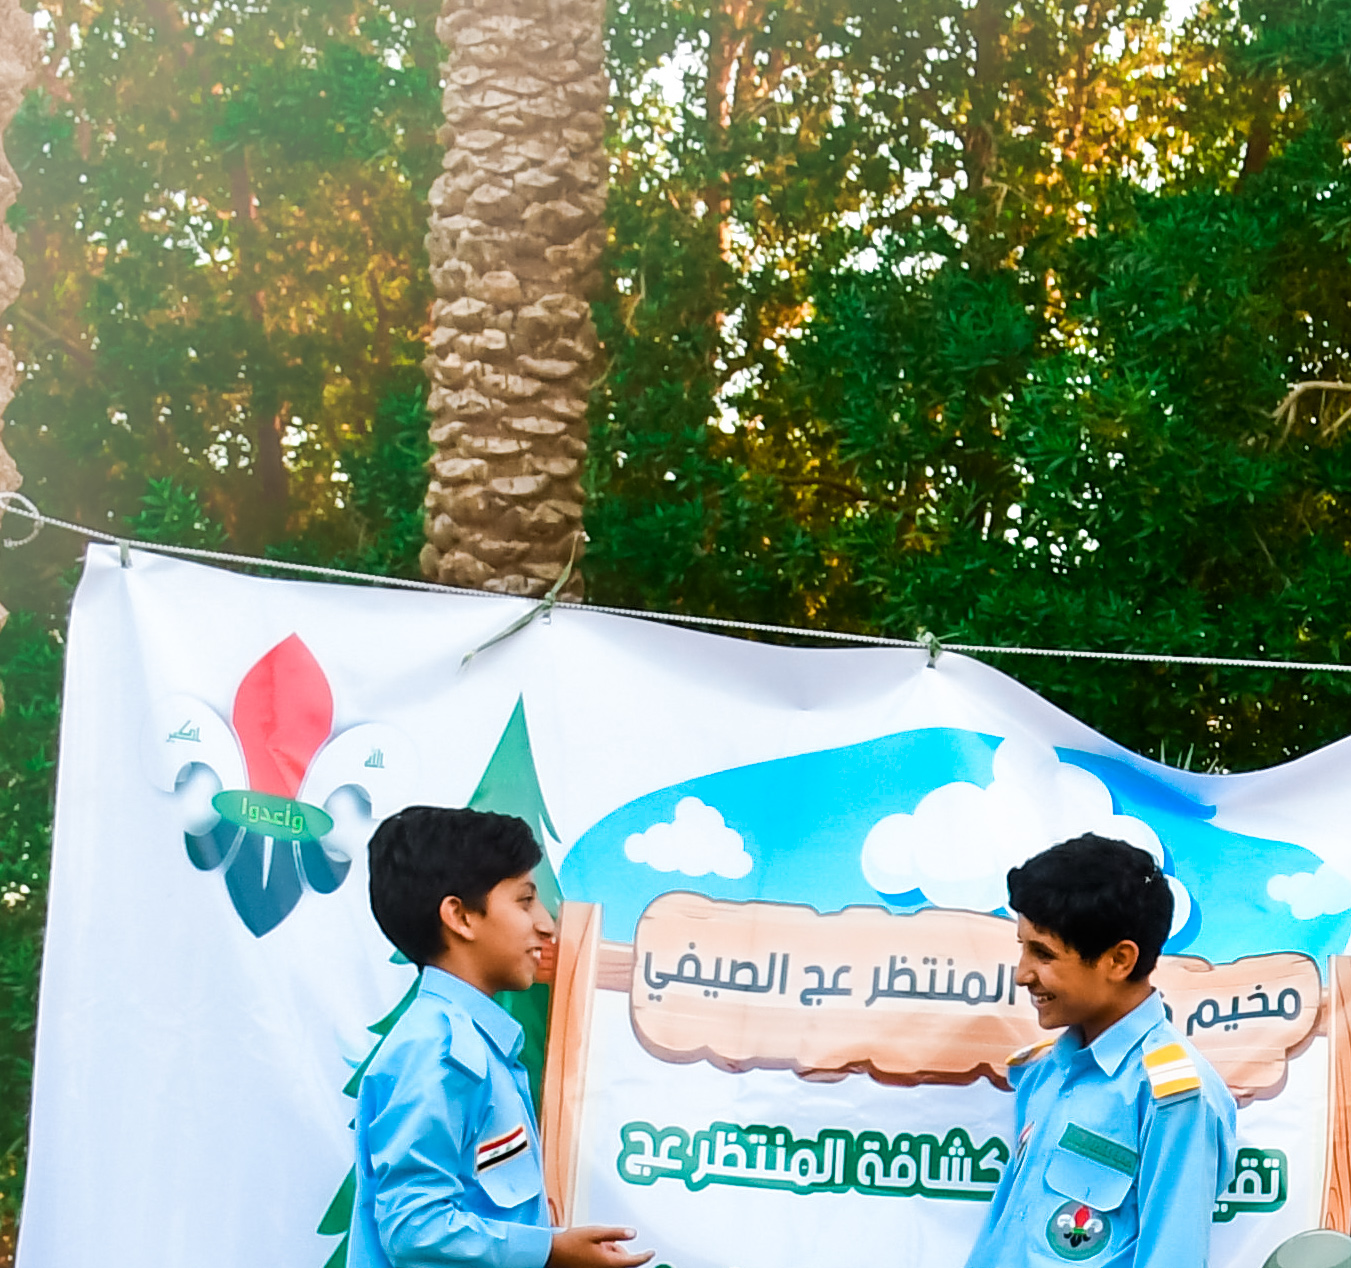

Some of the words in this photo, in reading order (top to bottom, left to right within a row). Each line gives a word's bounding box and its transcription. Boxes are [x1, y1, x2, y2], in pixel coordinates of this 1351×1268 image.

[643, 942, 790, 1002] الصيفي
[799, 964, 852, 1006] عج
[864, 954, 1017, 1007] المنتظر
[1186, 984, 1302, 1037] مخيم
[625, 1130, 682, 1177] عج
[690, 1130, 846, 1186] المنتظر
[856, 1136, 1005, 1191] كشافة
